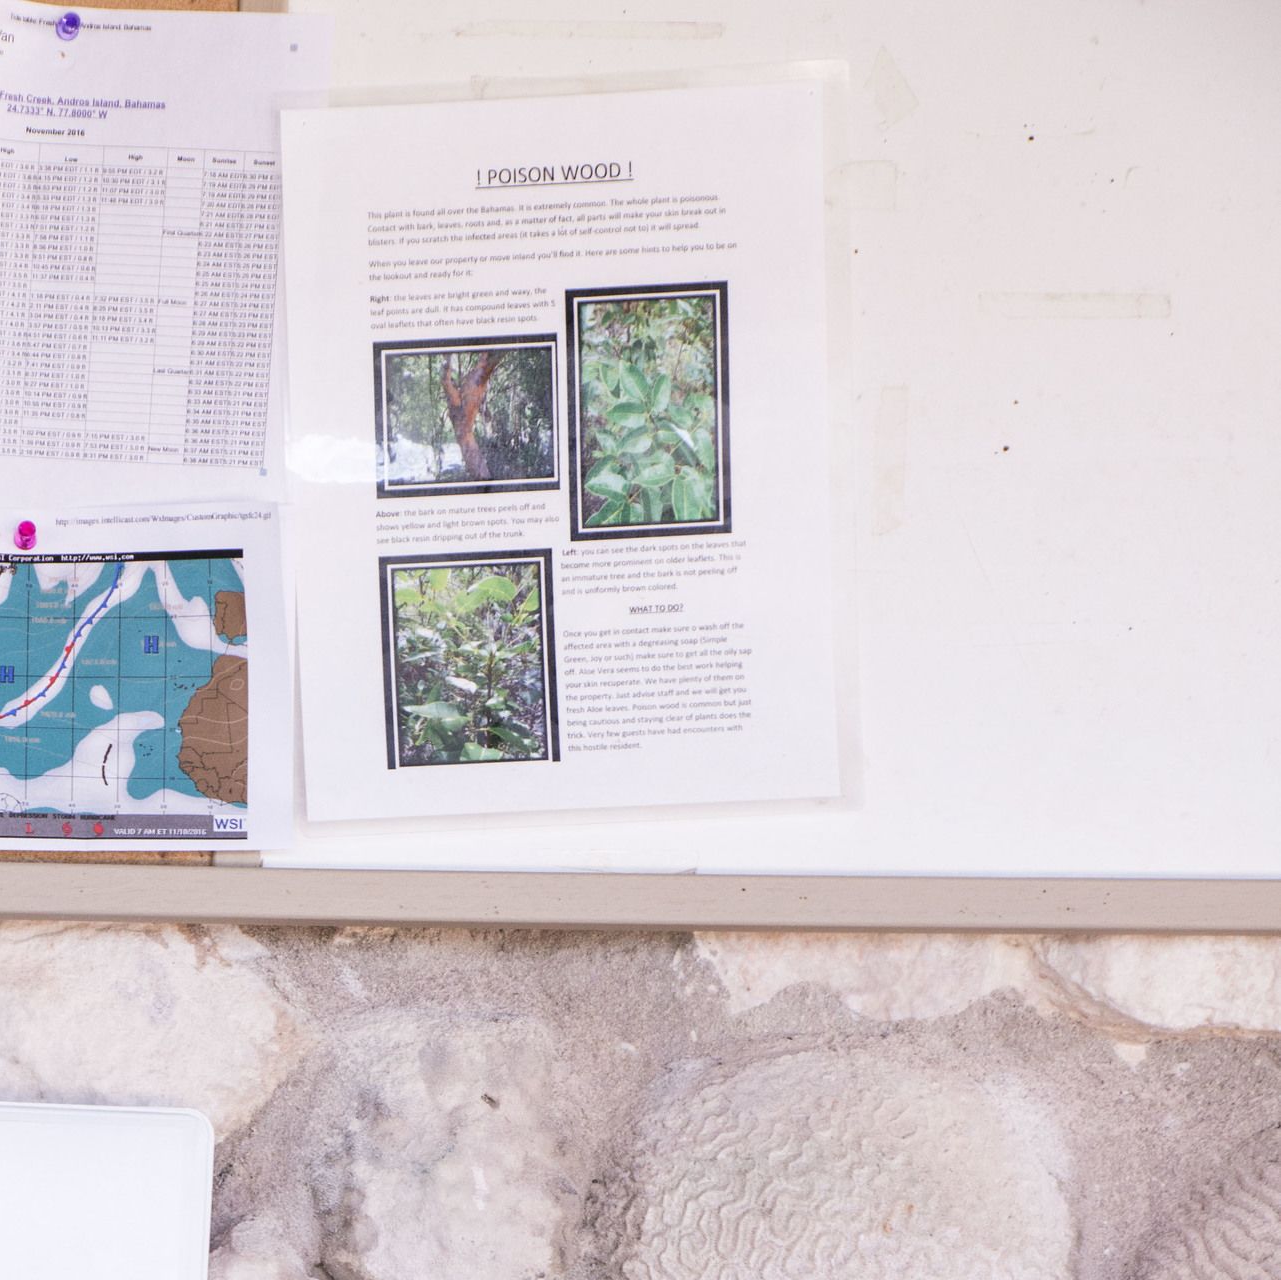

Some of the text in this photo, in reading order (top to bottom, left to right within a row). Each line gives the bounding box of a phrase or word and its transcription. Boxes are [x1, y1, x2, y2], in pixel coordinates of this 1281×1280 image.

[26, 126, 85, 136] November 2016
[488, 166, 554, 184] POISON
[562, 162, 621, 180] WOOD
[414, 271, 427, 279] and
[430, 270, 451, 280] ready
[453, 270, 463, 278] for
[629, 603, 683, 614] WHAT TO DO?
[215, 818, 243, 830] WSI
